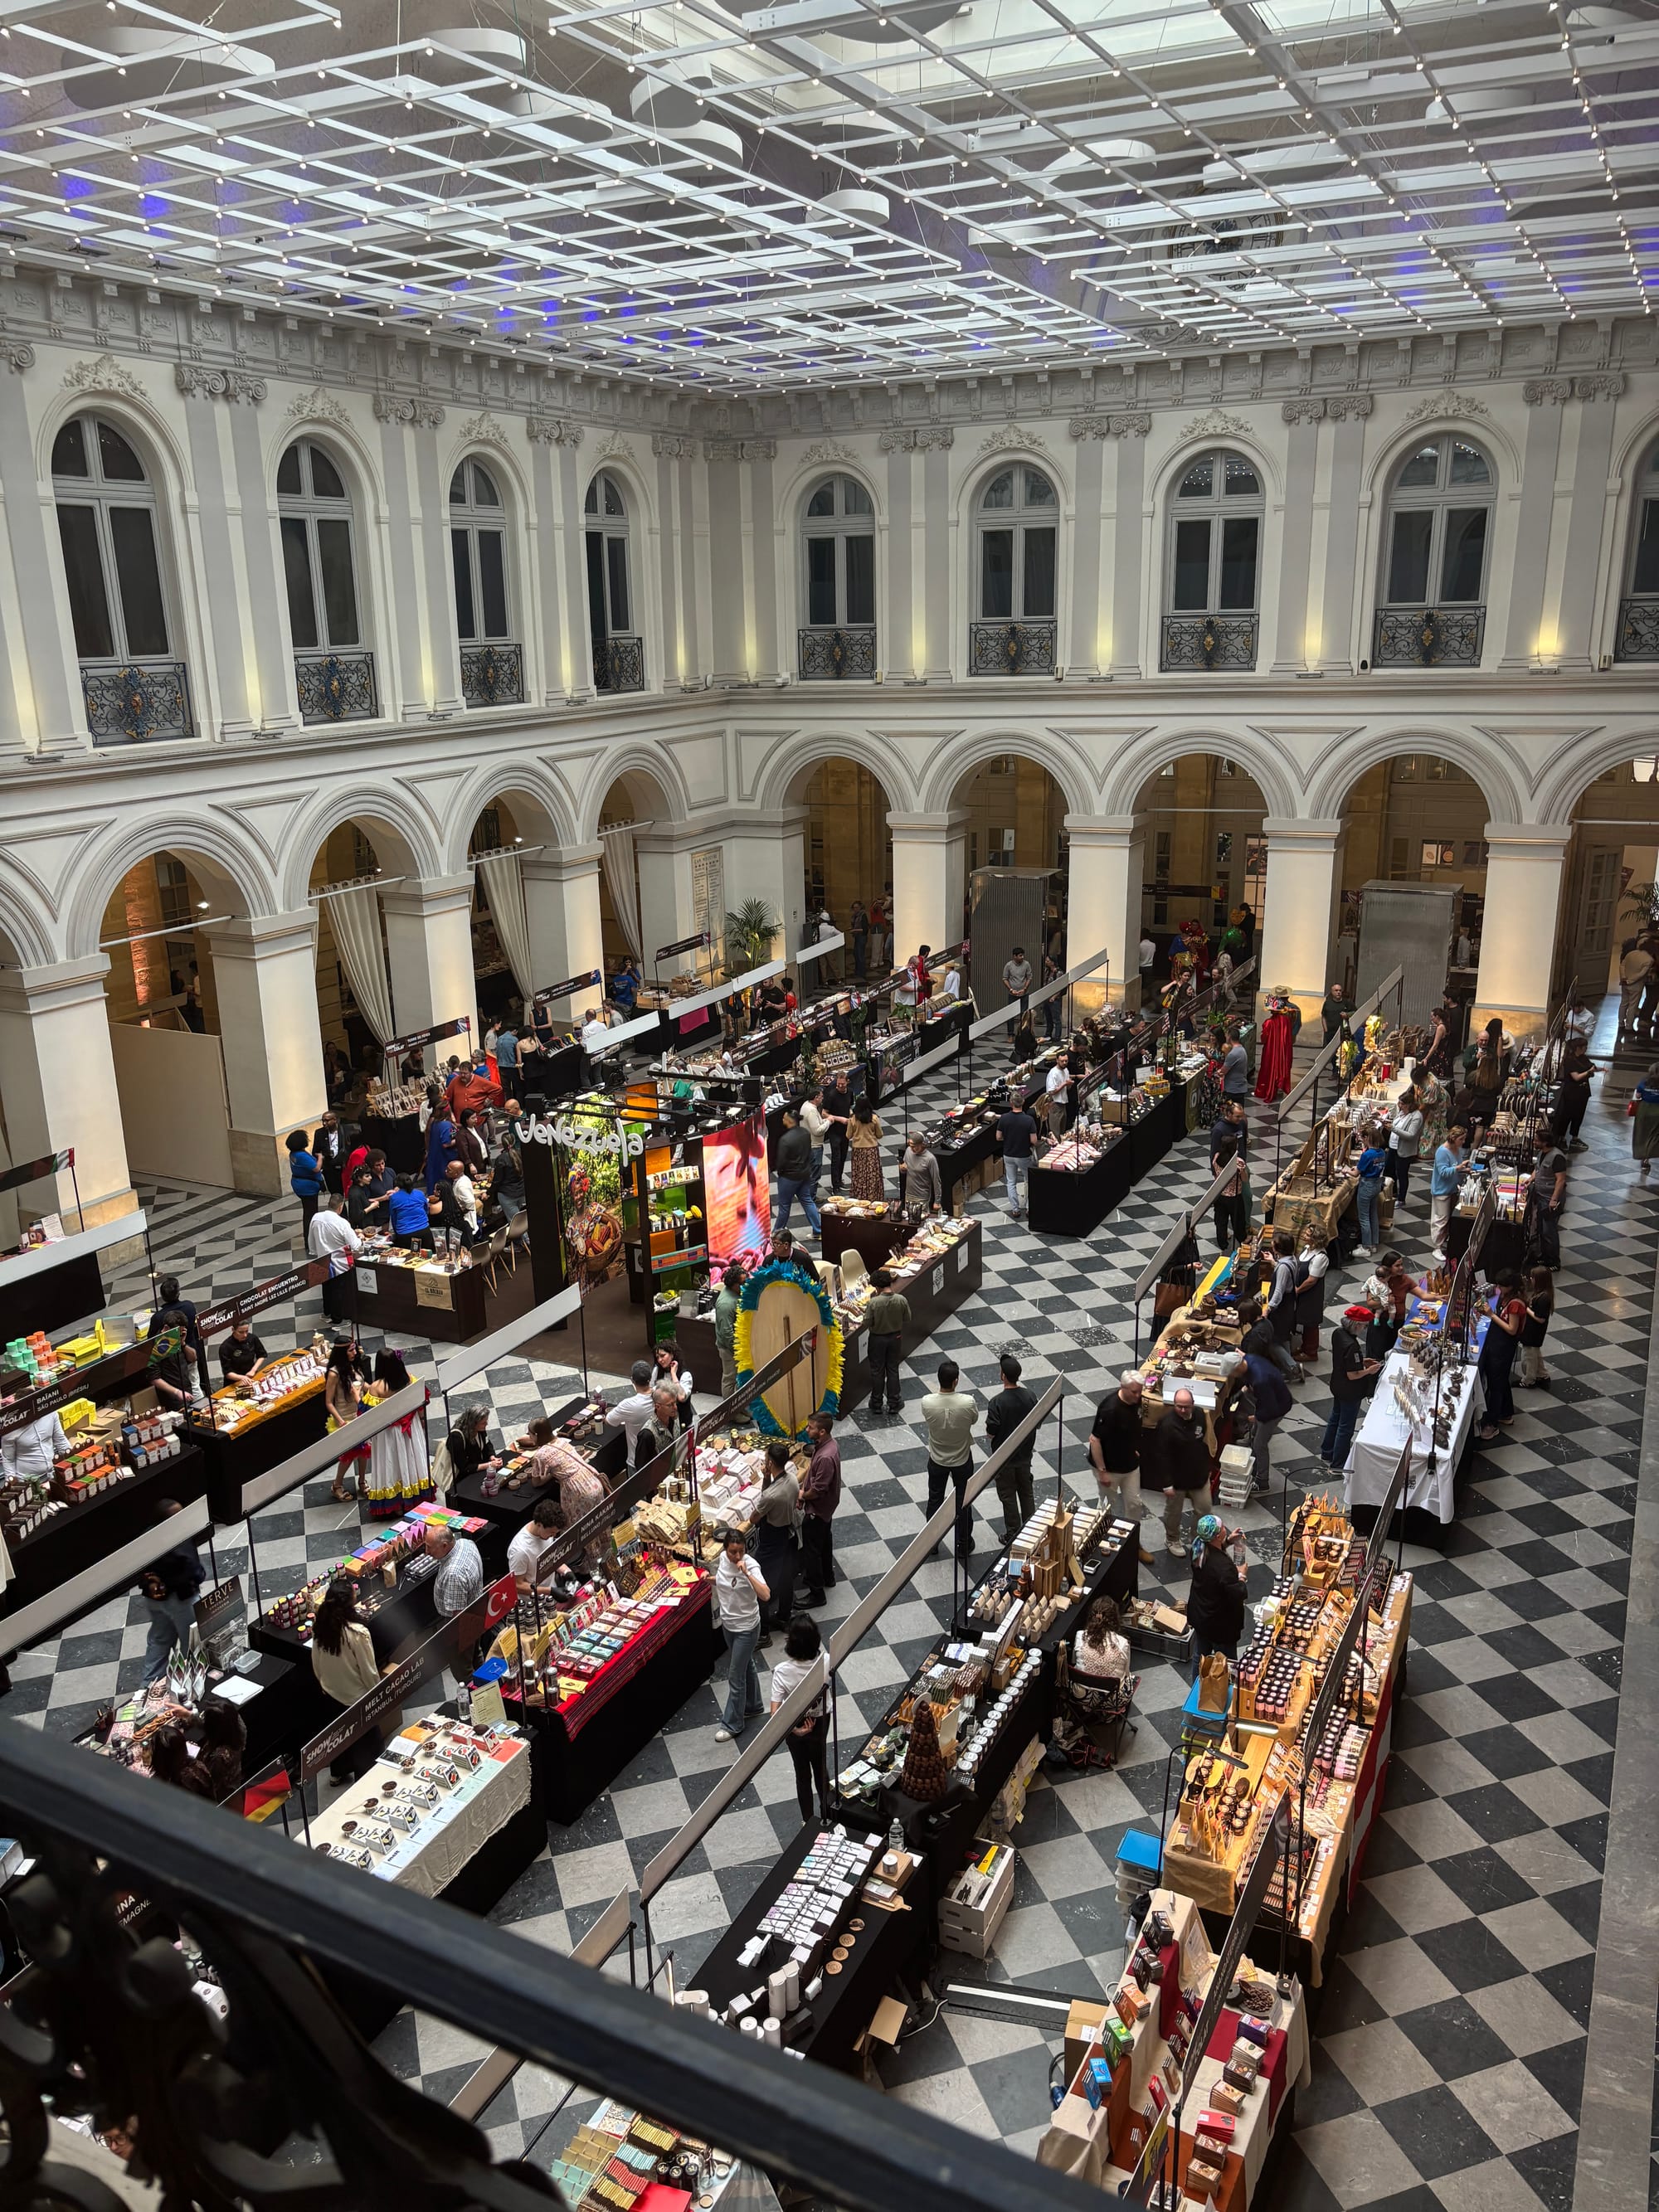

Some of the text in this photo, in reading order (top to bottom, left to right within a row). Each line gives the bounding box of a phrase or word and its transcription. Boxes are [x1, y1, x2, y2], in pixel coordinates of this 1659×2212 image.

[239, 1275, 299, 1306] CHOCOLAT ENCUENTRO
[241, 1303, 254, 1314] SAINT
[277, 1288, 288, 1298] LILLE
[200, 1313, 217, 1327] SHOW
[215, 1310, 235, 1325] COLAT
[36, 1389, 60, 1404] BAÏANI
[36, 1403, 49, 1412] SÃO
[50, 1393, 67, 1406] PAULO
[3, 1410, 28, 1427] COLAT
[581, 1519, 594, 1534] NINA
[595, 1502, 615, 1521] KAKAW
[538, 1548, 558, 1571] SHOW
[552, 1542, 574, 1563] COLAT
[201, 1581, 234, 1609] TERVE
[364, 1656, 425, 1713] MELT CACAO LAB
[365, 1670, 422, 1723] ISTANBUL (TURQUIE)
[305, 1734, 333, 1765] SHOW
[326, 1724, 356, 1754] COLAT
